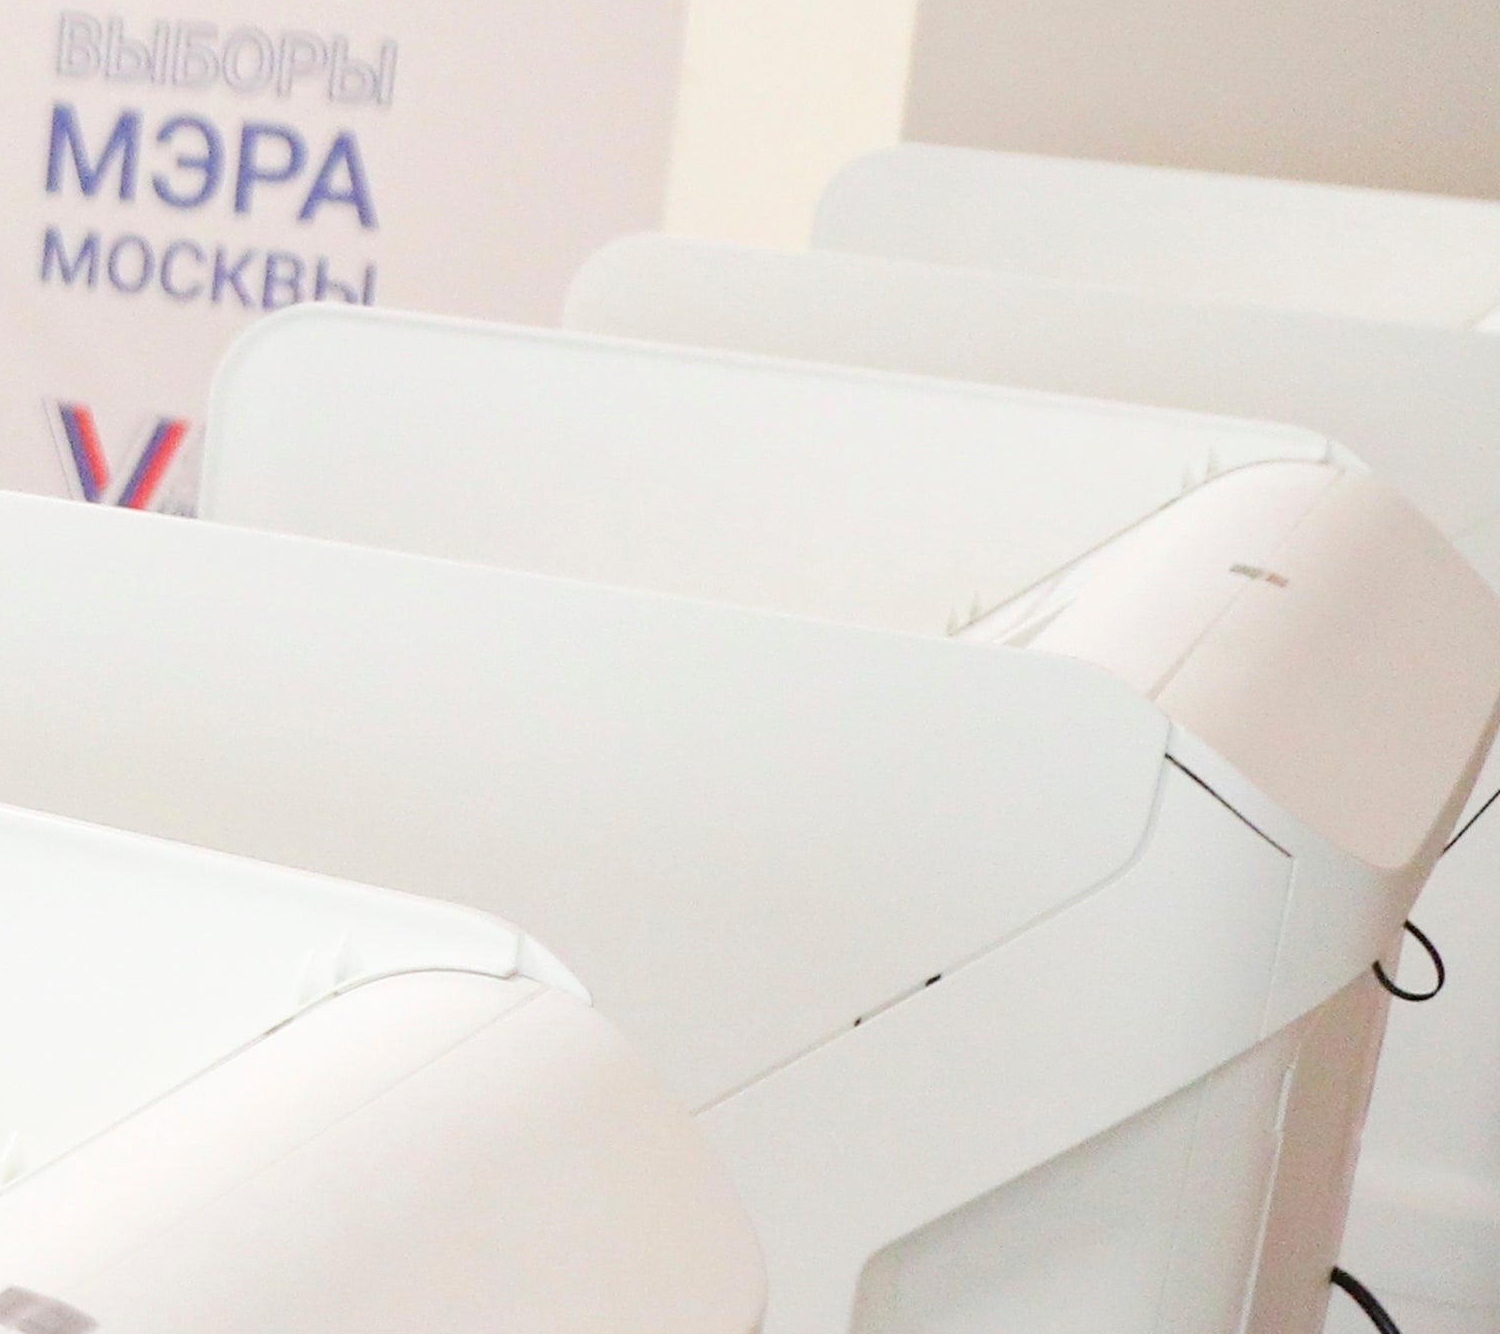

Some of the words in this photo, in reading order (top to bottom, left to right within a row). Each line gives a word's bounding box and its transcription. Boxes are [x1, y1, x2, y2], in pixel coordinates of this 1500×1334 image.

[55, 10, 399, 108] ВЫБОРЫ
[44, 101, 379, 231] МЭРА
[38, 224, 378, 310] МОСКВЫ
